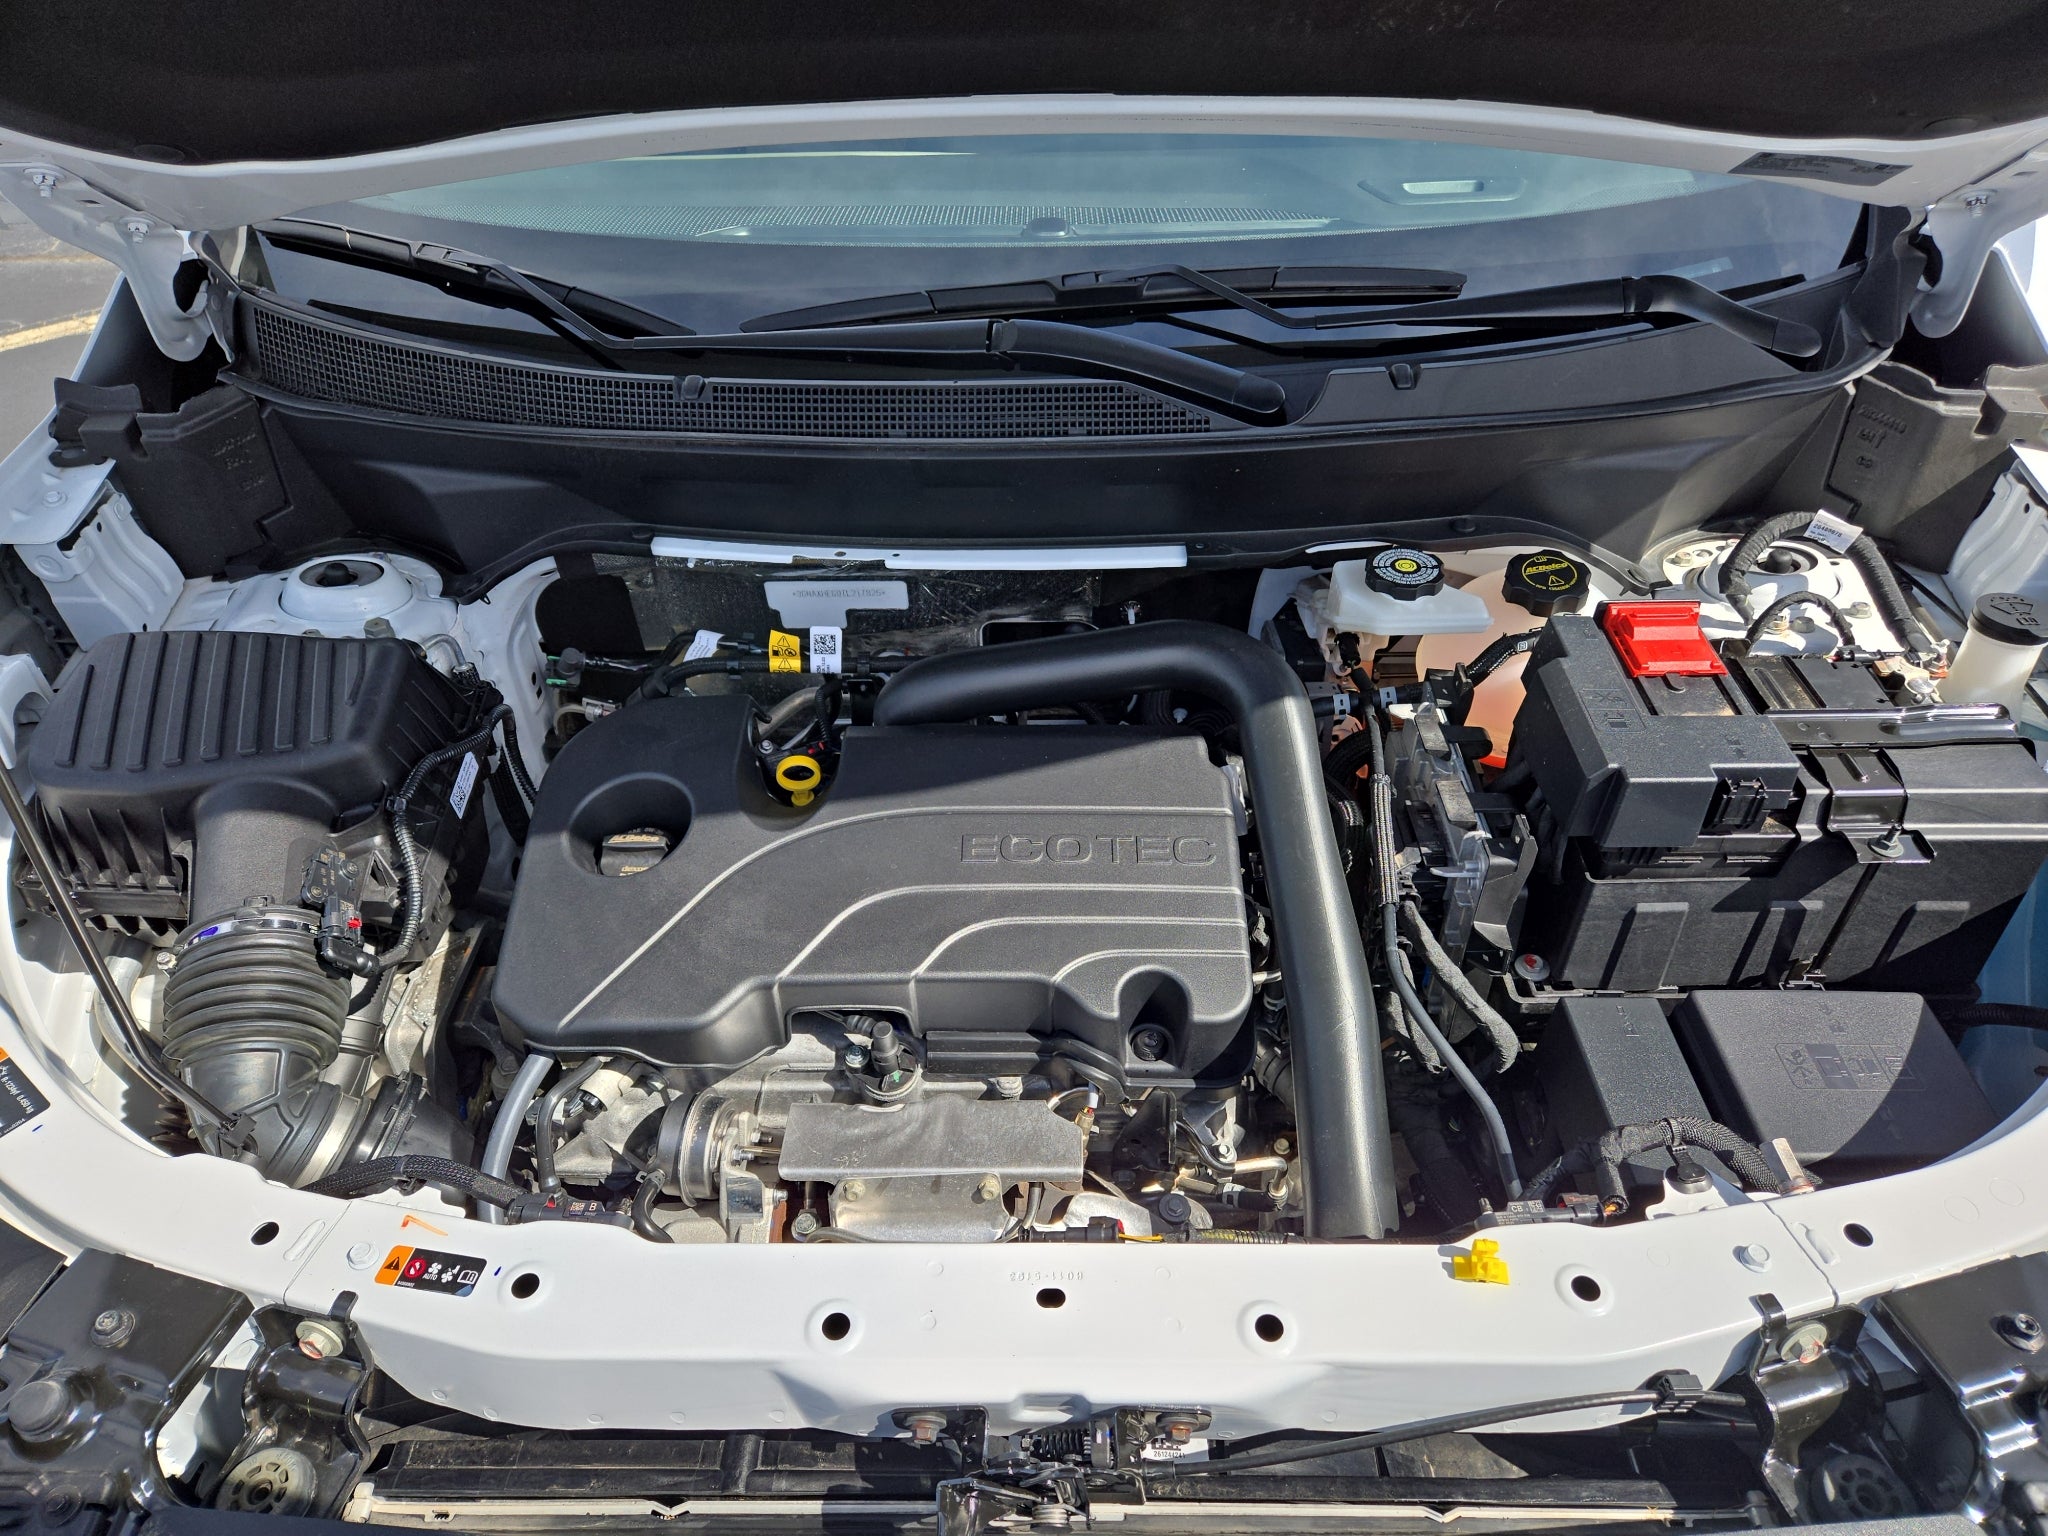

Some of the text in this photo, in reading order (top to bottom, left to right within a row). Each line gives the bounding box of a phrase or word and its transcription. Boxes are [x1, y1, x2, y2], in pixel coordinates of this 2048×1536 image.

[1526, 562, 1568, 574] ACDelco
[608, 834, 660, 843] ACDelco
[960, 834, 1217, 866] ECOTEC
[422, 1273, 438, 1281] AUTO
